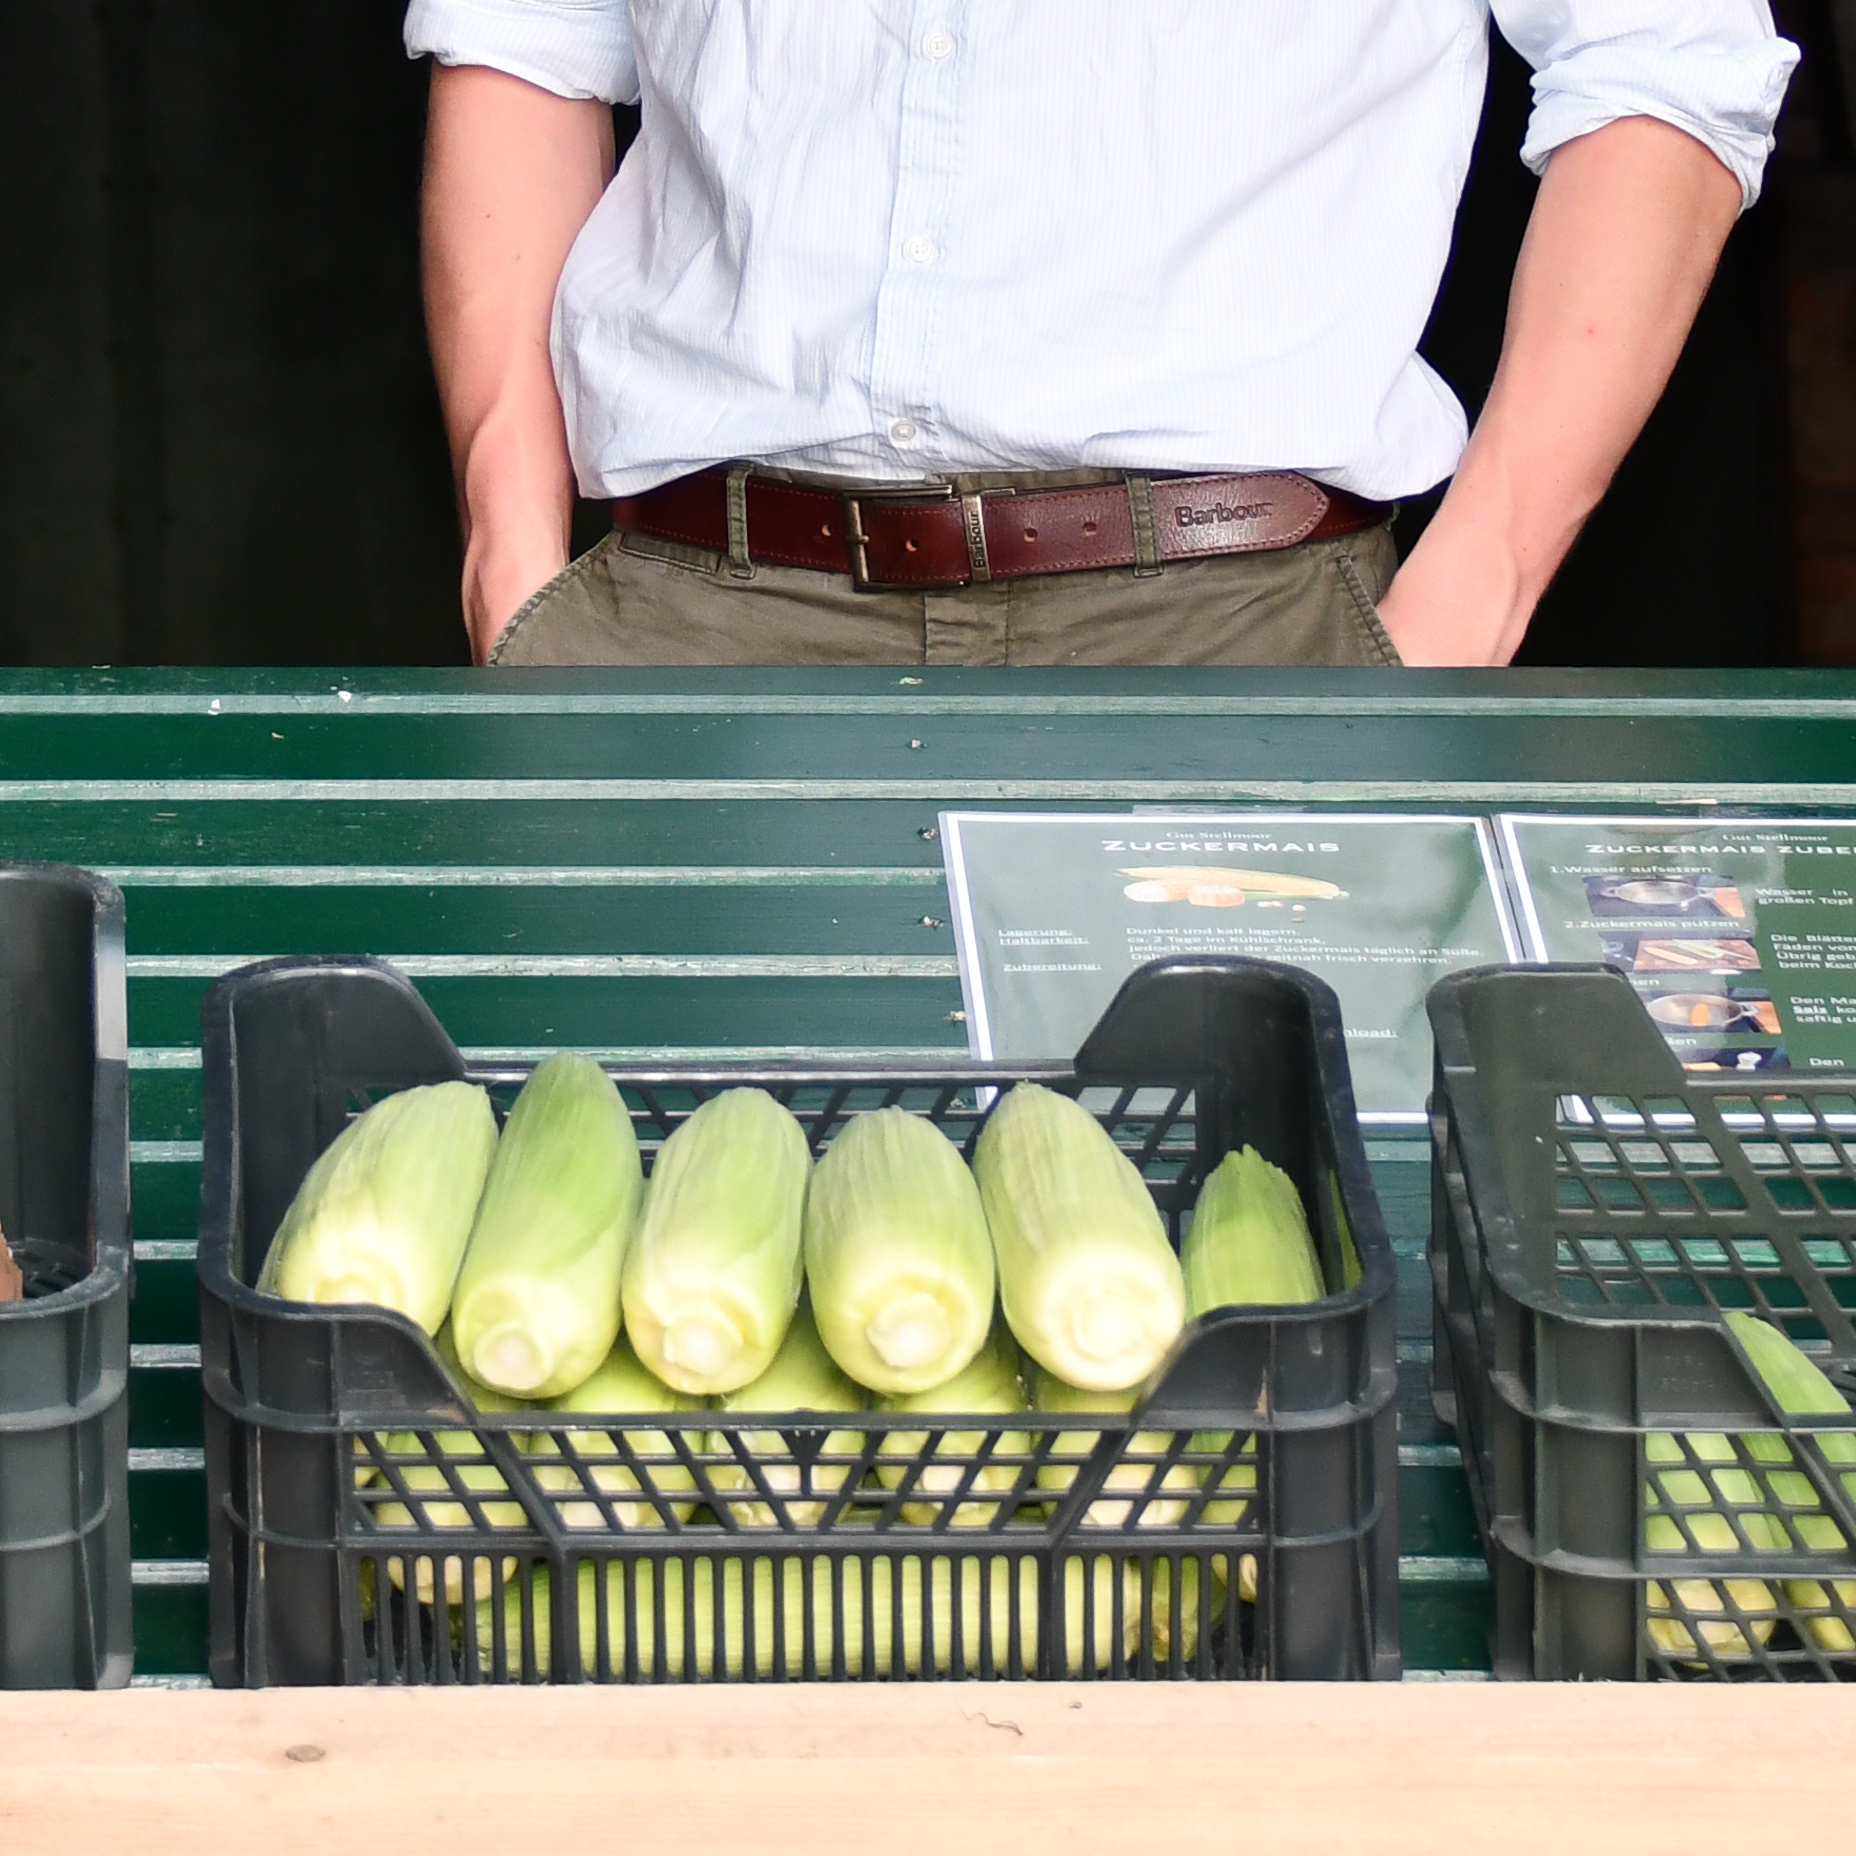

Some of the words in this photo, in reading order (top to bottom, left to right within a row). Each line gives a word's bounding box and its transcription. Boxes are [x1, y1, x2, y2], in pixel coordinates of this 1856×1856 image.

[1174, 500, 1273, 528] Barbour
[971, 510, 987, 570] Barbour
[1100, 840, 1341, 853] ZUCKERMAIS
[1584, 844, 1766, 855] ZUCKERMAIS
[1754, 888, 1813, 896] Wasser
[1832, 888, 1849, 897] in
[1820, 896, 1854, 907] Topf
[1680, 920, 1739, 931] putzen
[1126, 927, 1179, 935] Dunkel
[1183, 927, 1212, 935] und
[1216, 927, 1244, 935] kalt
[1127, 936, 1147, 944] ca.
[1168, 936, 1200, 946] Tage
[1206, 936, 1225, 944] im
[1770, 934, 1798, 942] Die
[1129, 944, 1180, 954] jedoch
[1243, 944, 1270, 953] der
[1274, 945, 1360, 955] Zuckermais
[1779, 961, 1821, 970] beim
[1790, 996, 1825, 1005] Den
[1796, 1014, 1842, 1024] saftig
[1809, 1057, 1844, 1067] Den
